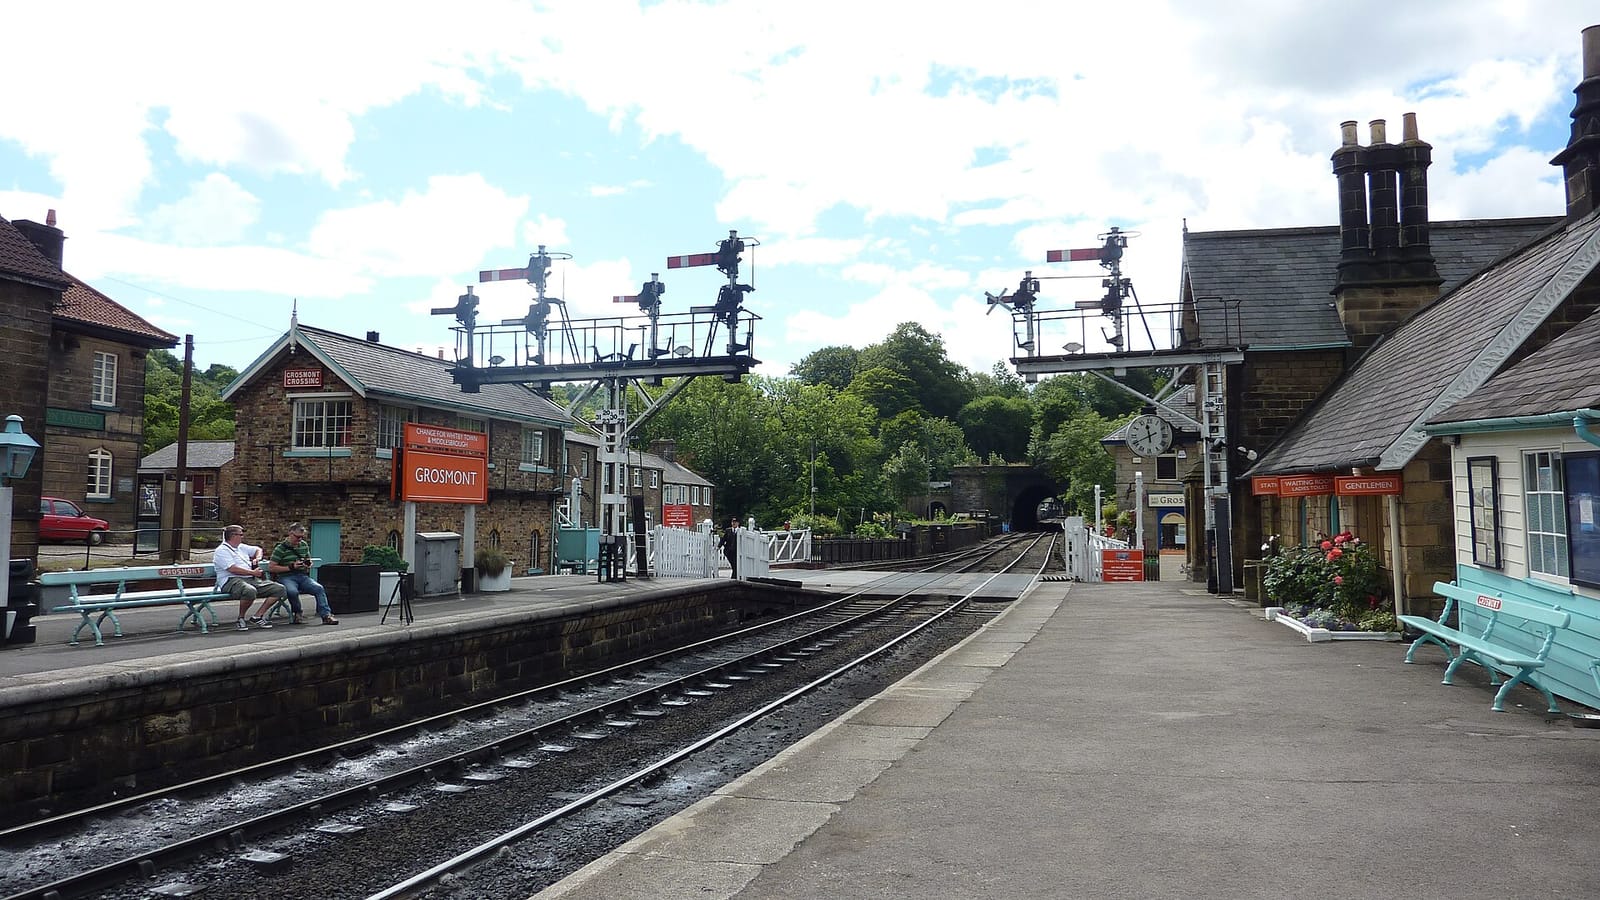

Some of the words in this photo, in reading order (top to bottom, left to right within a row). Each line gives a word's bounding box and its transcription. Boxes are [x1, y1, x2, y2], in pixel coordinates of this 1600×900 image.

[415, 467, 478, 486] GROSMONT
[1285, 479, 1313, 487] WAITING
[1344, 481, 1393, 490] GENTLEMEN
